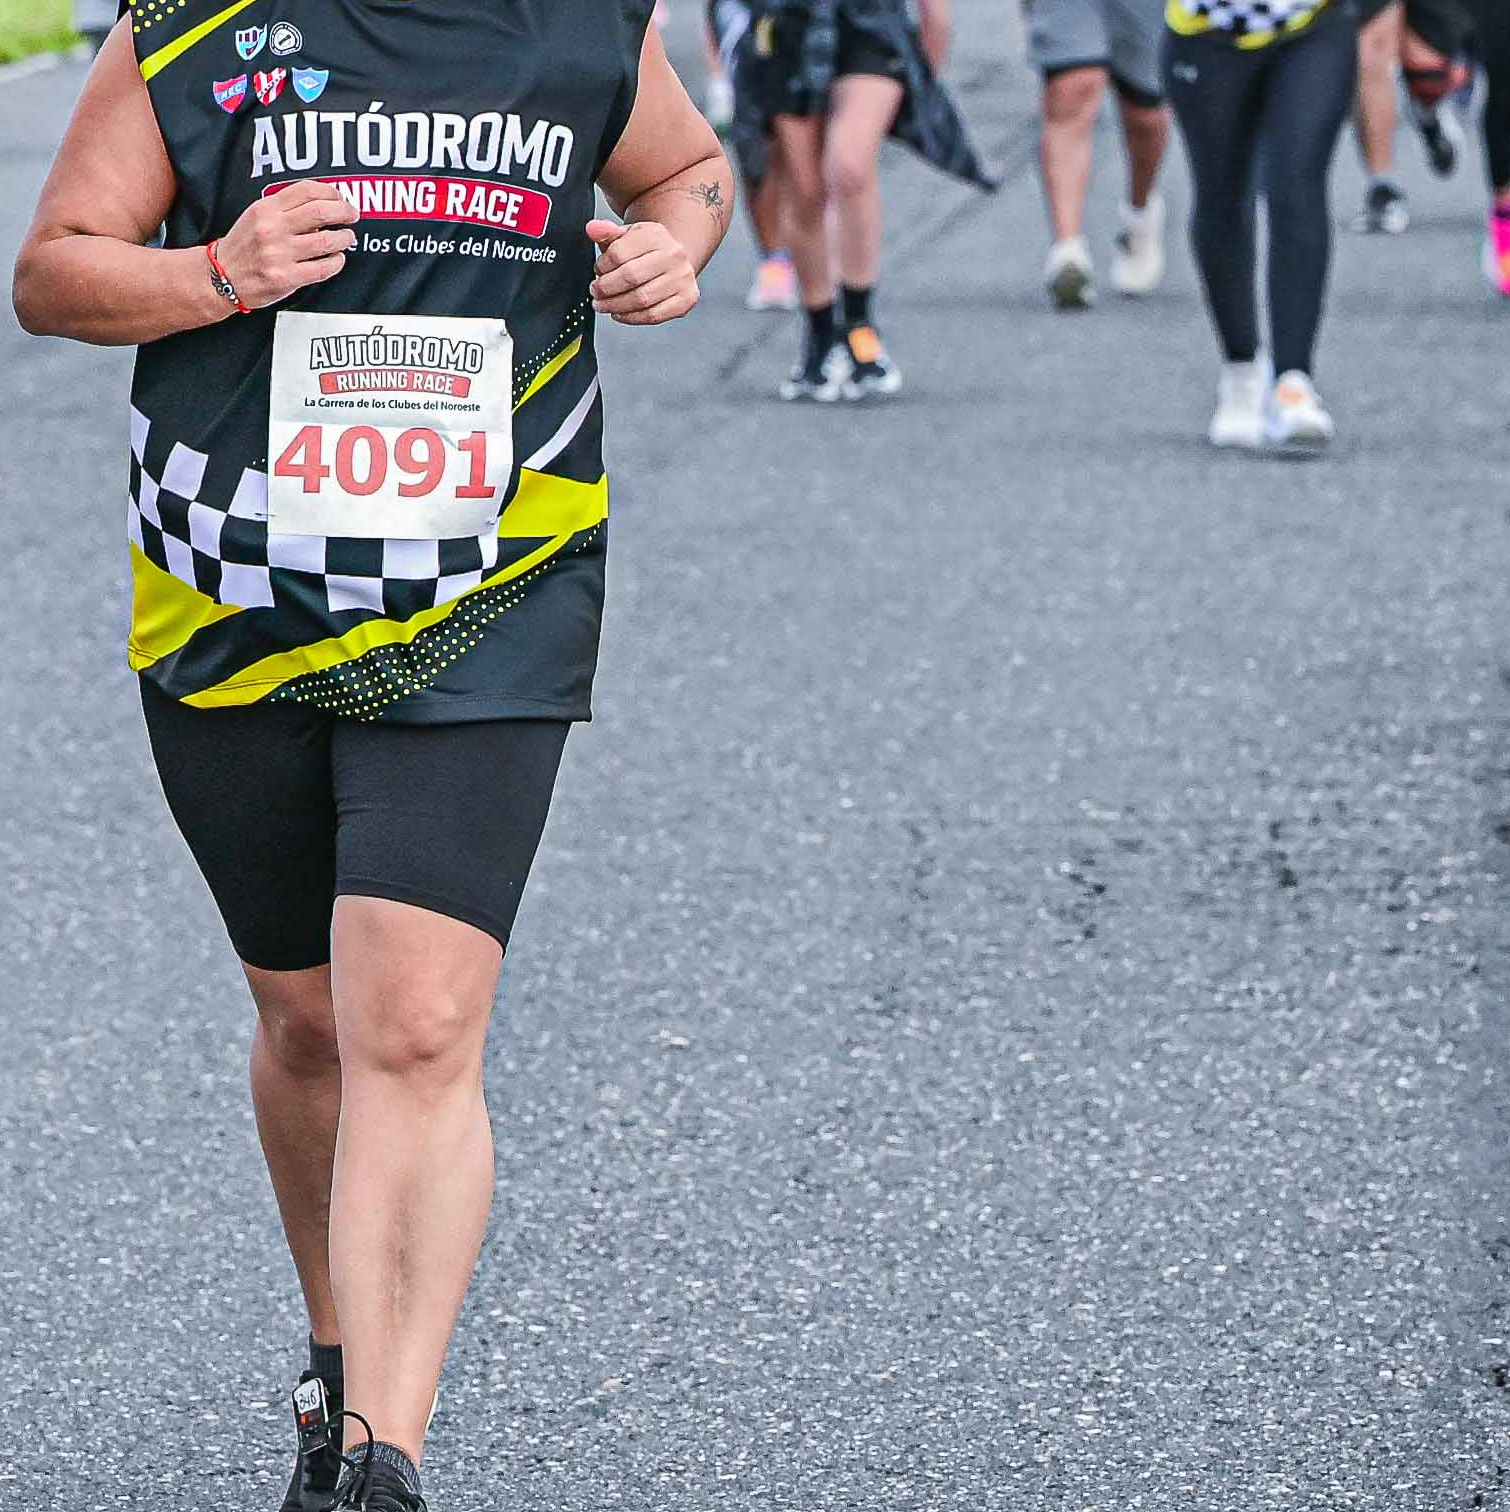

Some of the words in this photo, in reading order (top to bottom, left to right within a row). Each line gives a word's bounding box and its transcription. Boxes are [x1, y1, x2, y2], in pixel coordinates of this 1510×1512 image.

[251, 101, 574, 188] AUTÓDROMO
[330, 179, 437, 214] NNING
[445, 182, 523, 228] RACE
[363, 233, 391, 253] los
[395, 234, 455, 255] Clubes
[458, 237, 489, 257] del
[492, 239, 556, 264] Noroeste
[309, 325, 484, 374] AUTÓDROMO
[304, 396, 316, 407] La
[317, 397, 354, 408] Carrera
[356, 398, 370, 408] de
[371, 398, 386, 409] los
[387, 399, 421, 410] Clubes
[423, 399, 439, 410] del
[440, 401, 481, 412] Noroeste
[336, 371, 408, 392] RUNNING
[412, 372, 455, 394] RACE
[274, 425, 496, 499] 4091
